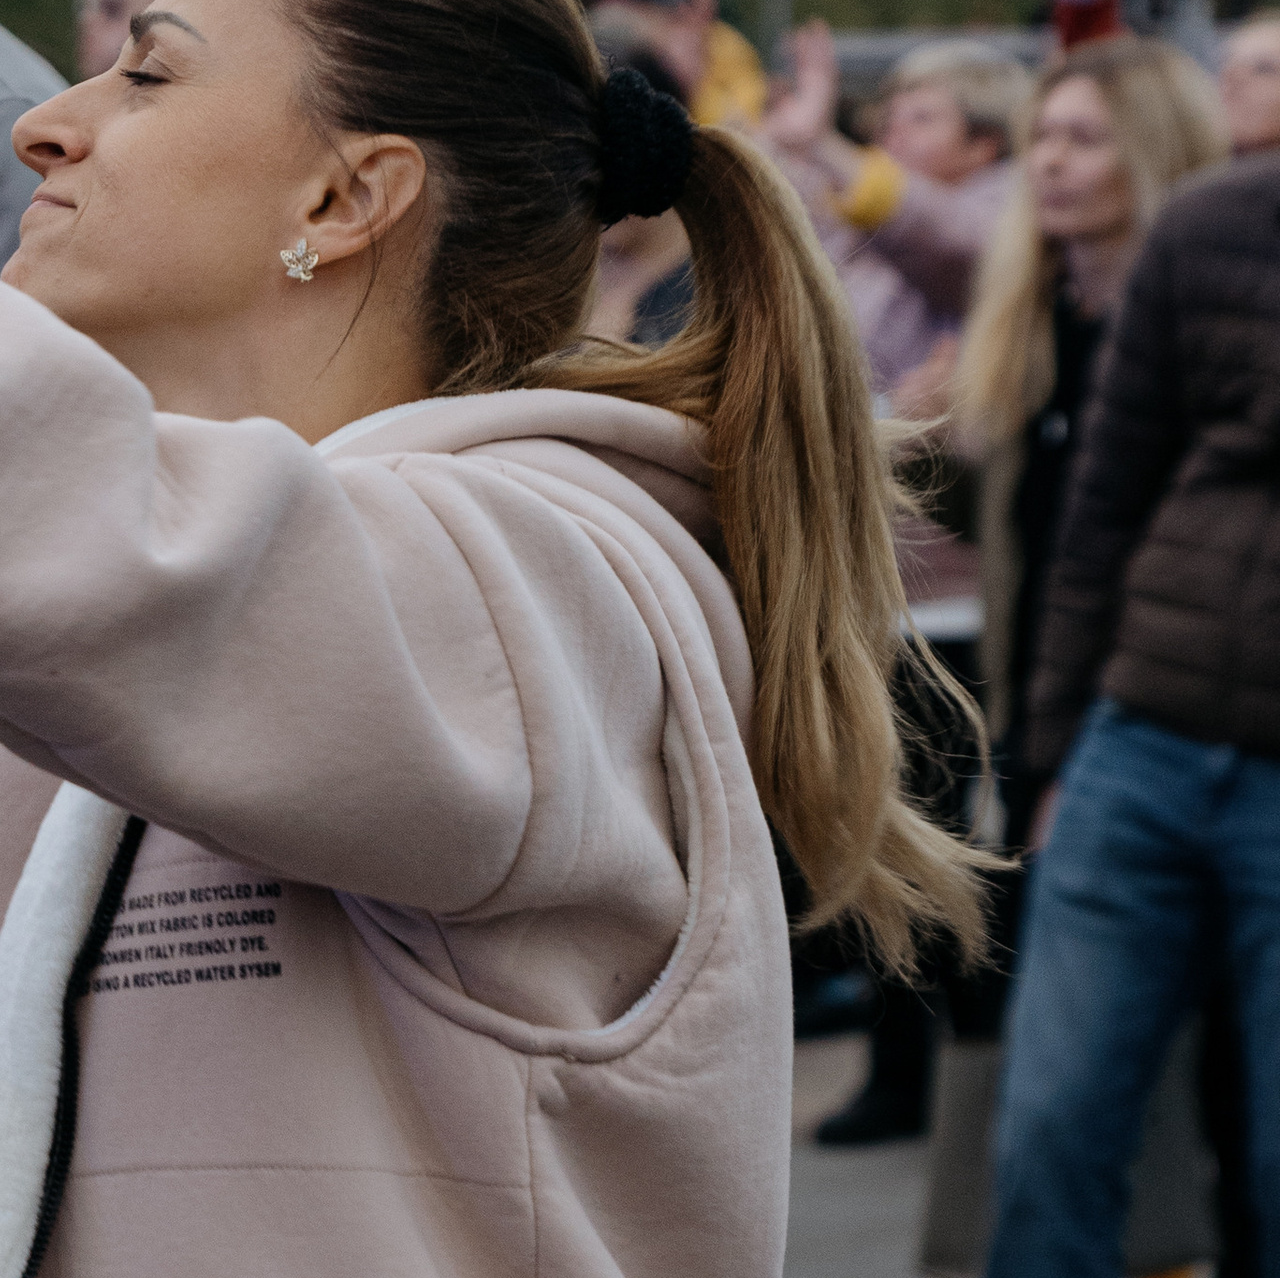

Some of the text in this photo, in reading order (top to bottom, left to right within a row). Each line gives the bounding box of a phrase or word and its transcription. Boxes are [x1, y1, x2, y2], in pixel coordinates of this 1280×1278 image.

[128, 894, 154, 910] MADE
[157, 890, 186, 907] FROM
[189, 883, 252, 903] RECYCLED
[256, 882, 282, 898] AND
[137, 919, 156, 935] MIX
[159, 914, 199, 933] FABRIC
[202, 913, 213, 930] IS
[216, 908, 276, 928] COLORED
[144, 943, 175, 961] ITALY
[240, 936, 269, 952] DYE.
[122, 974, 130, 989] A
[133, 968, 191, 989] RECYCLED
[194, 964, 236, 982] WATER
[239, 962, 282, 979] SYSEM
